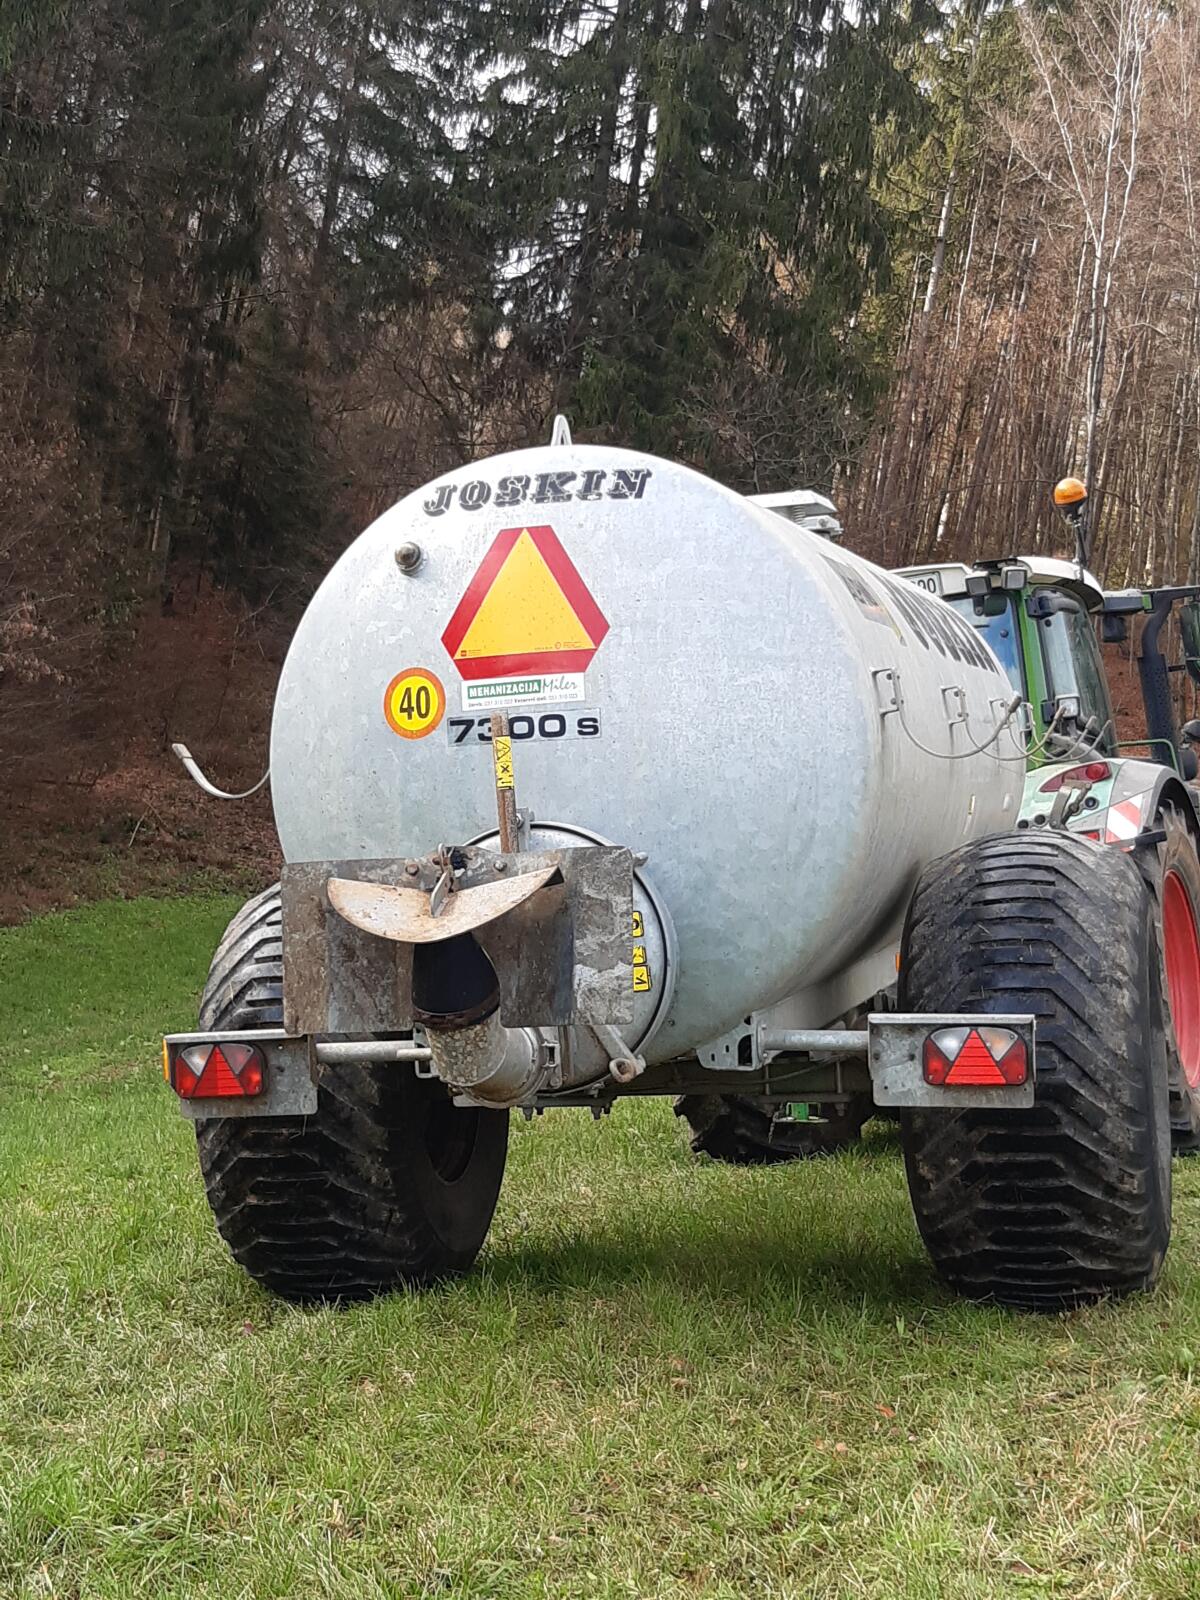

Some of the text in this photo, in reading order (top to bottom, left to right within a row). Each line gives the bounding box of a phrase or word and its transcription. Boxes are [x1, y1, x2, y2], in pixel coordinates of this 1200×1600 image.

[423, 469, 652, 517] JOSKIN
[400, 686, 431, 720] 40
[468, 682, 540, 698] MEHANIZACIJA
